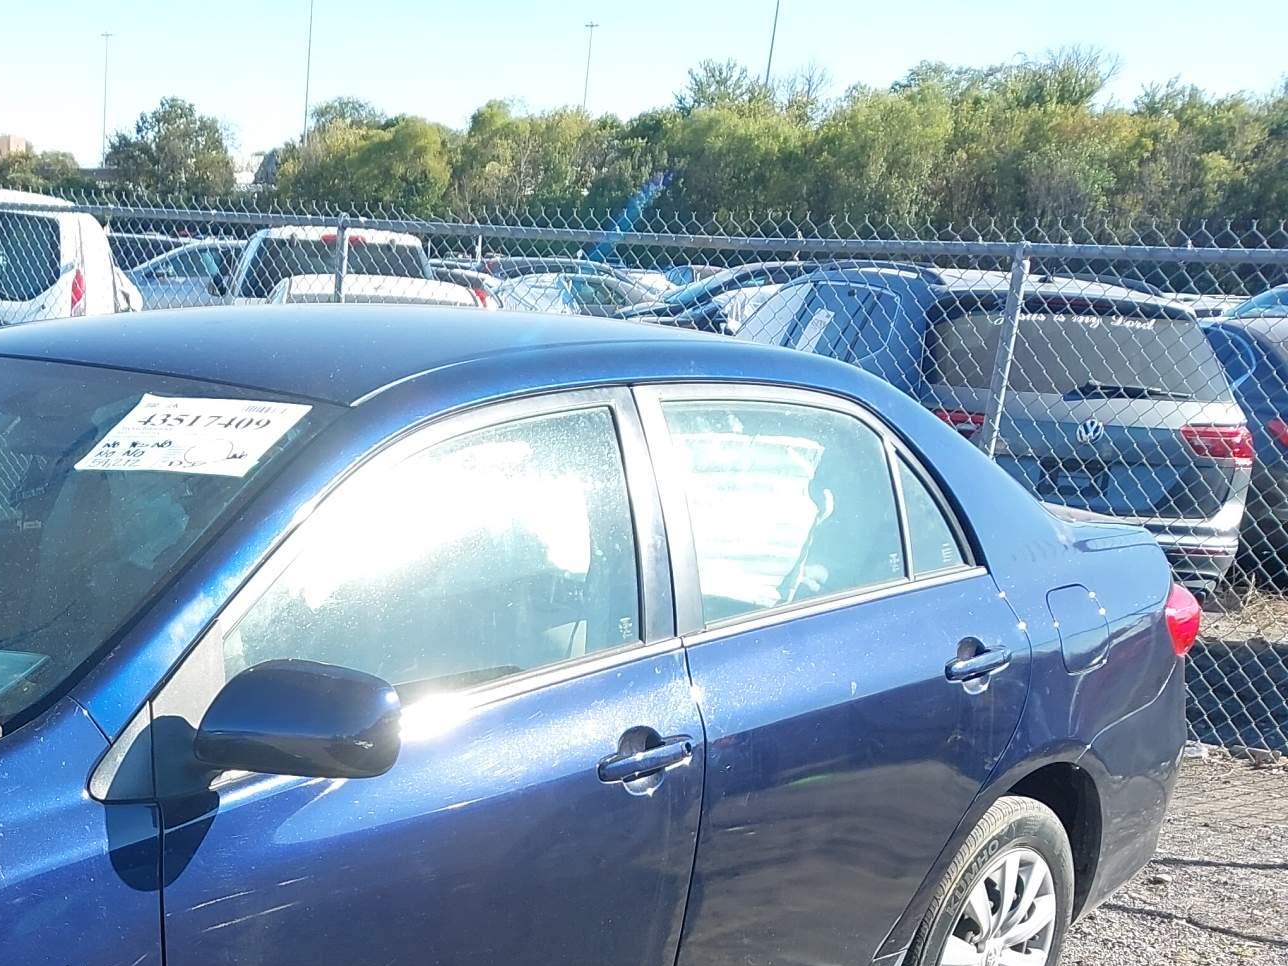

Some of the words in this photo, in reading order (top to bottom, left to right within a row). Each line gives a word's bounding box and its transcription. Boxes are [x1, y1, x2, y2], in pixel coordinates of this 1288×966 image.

[1110, 315, 1157, 330] Lord
[137, 413, 272, 430] 43517409
[944, 839, 999, 916] KUMHO
